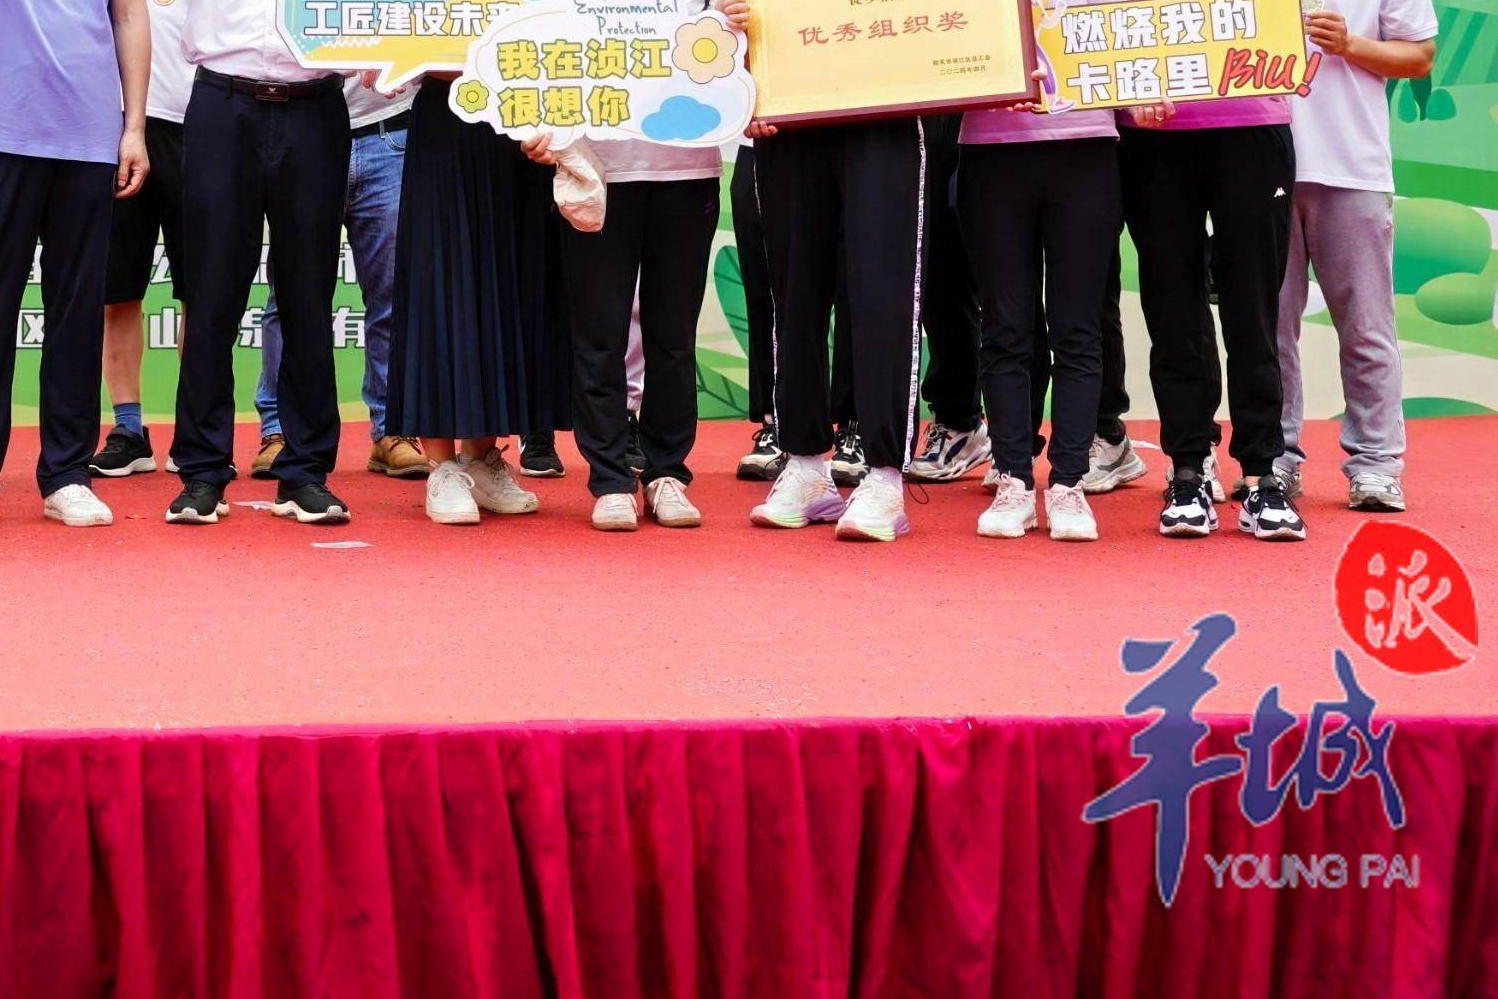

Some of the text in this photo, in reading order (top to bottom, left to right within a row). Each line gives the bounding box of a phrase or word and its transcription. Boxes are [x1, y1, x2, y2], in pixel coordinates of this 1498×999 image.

[598, 15, 657, 36] Protection
[797, 11, 969, 47] 优秀组织奖
[497, 38, 672, 80] 我在浈江
[1067, 53, 1213, 105] 卡路里
[498, 86, 630, 128] 很想你
